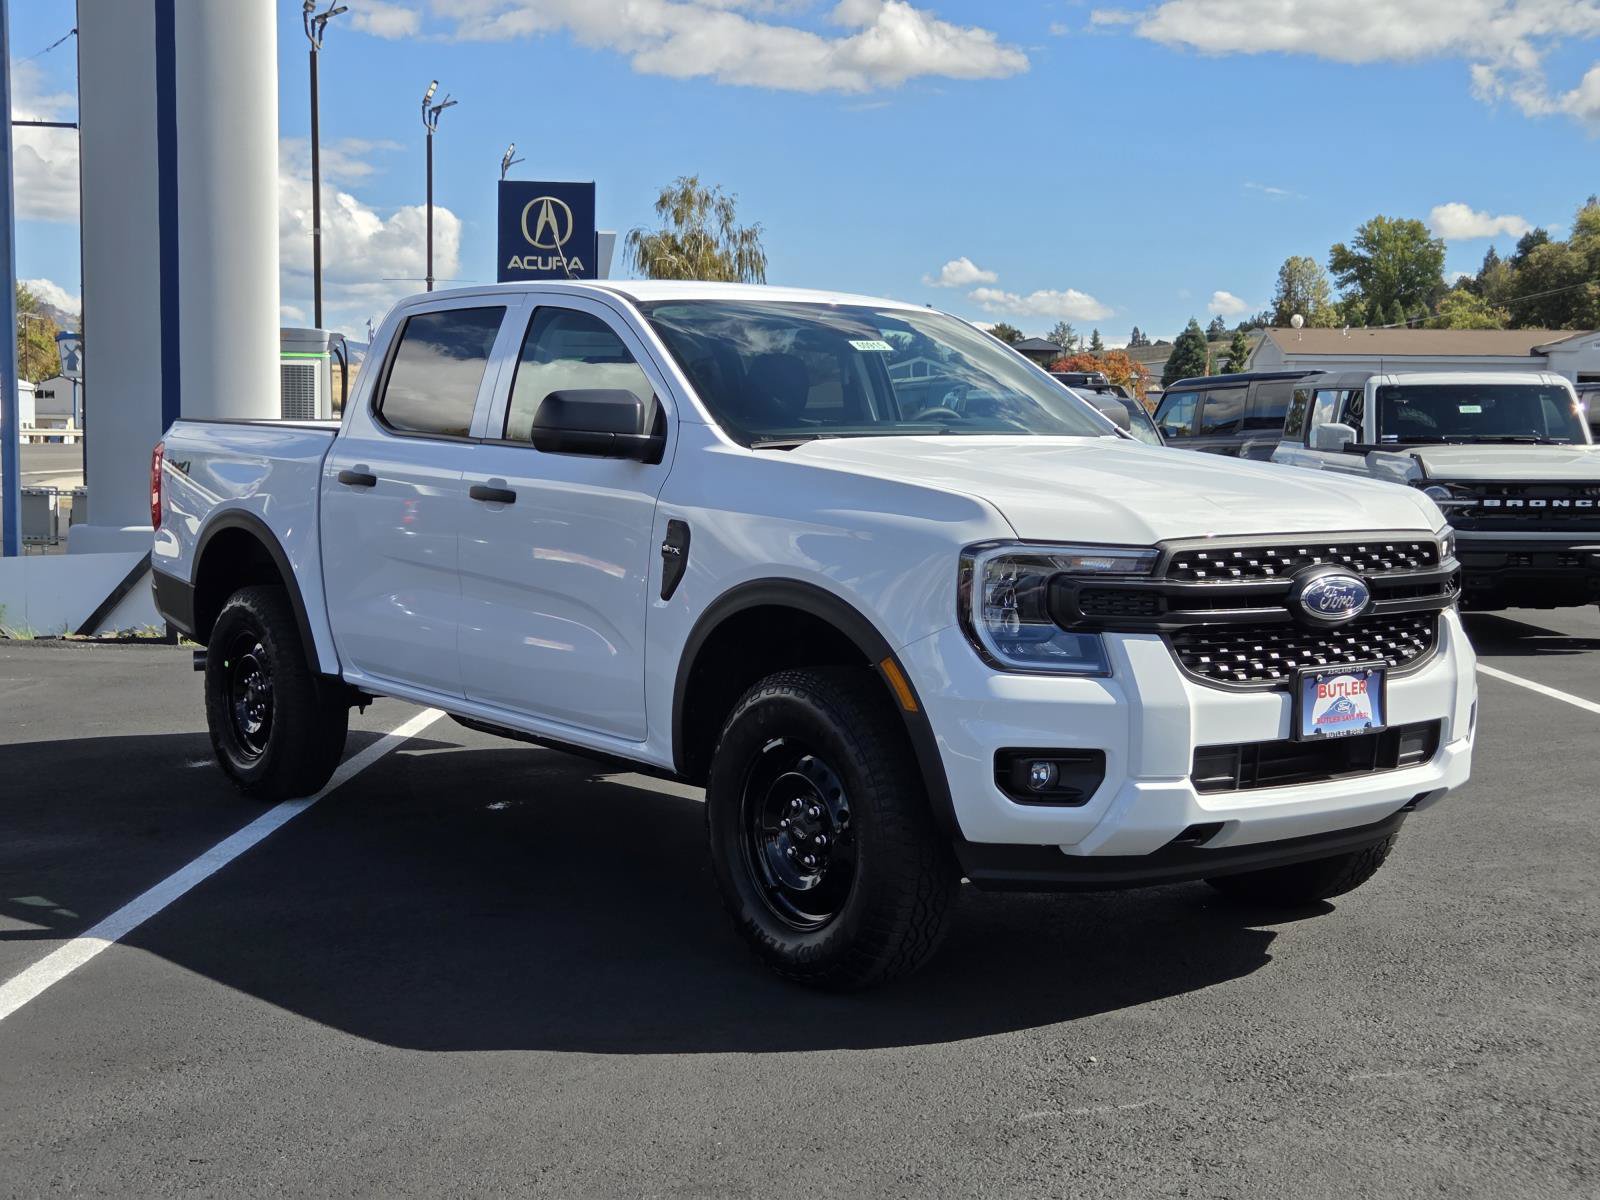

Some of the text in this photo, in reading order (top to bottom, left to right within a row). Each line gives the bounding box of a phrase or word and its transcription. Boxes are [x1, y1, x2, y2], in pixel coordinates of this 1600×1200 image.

[507, 255, 585, 271] ACURA
[1483, 499, 1600, 507] BRONC
[1320, 585, 1357, 610] Ford
[1318, 680, 1368, 698] BUTLER
